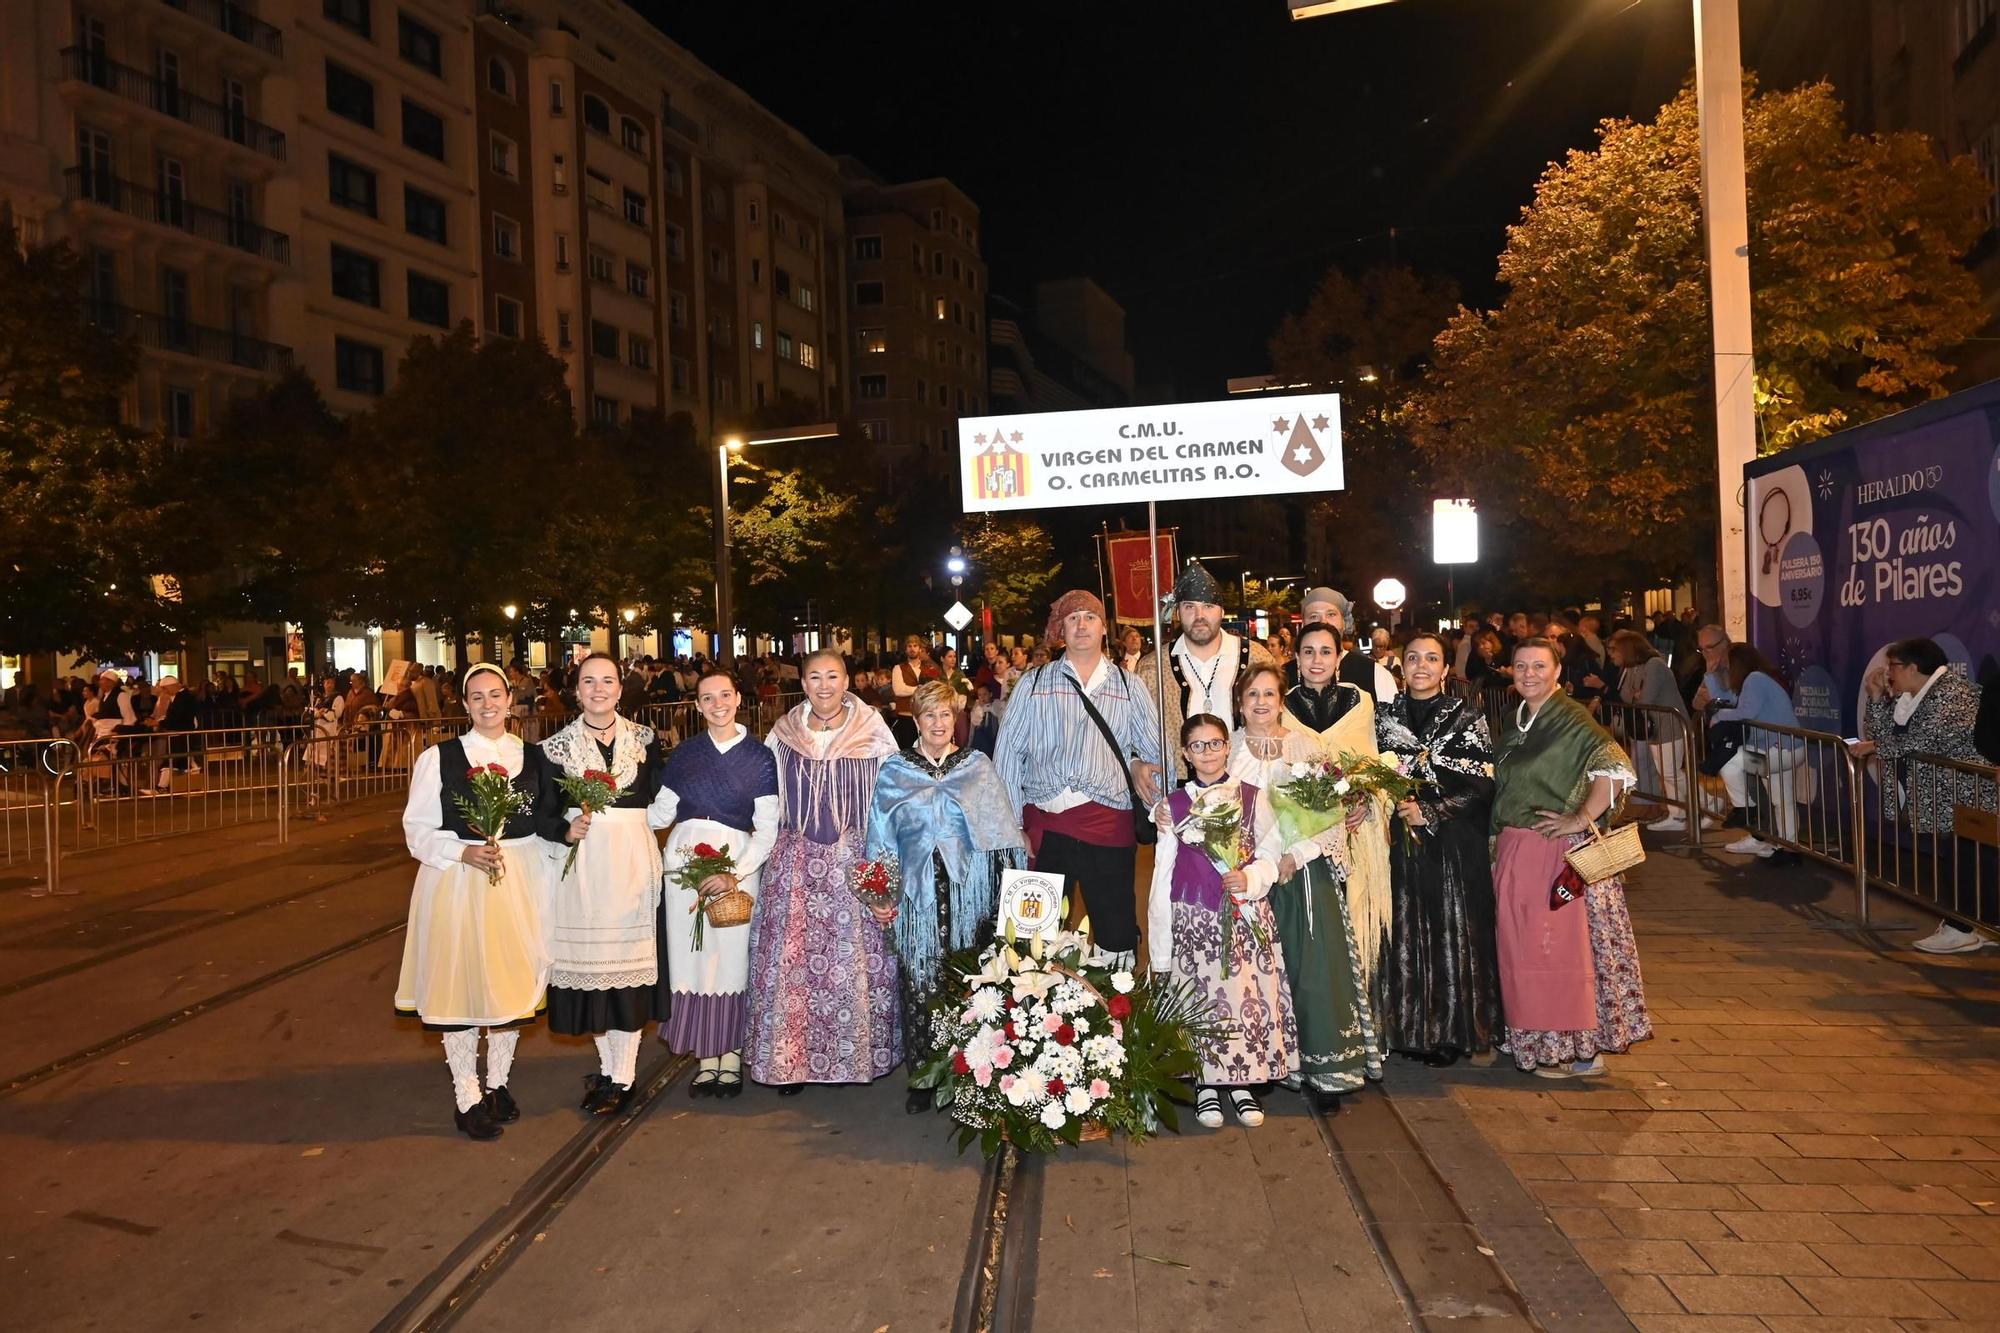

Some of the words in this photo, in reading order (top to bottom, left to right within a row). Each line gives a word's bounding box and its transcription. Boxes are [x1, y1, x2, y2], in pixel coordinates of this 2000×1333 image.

[1118, 421, 1183, 439] C.M.U.
[1041, 449, 1122, 468] VIRGEN
[1130, 445, 1168, 462] DEL
[1175, 439, 1264, 459] CARMEN
[1047, 475, 1072, 491] O.
[1080, 466, 1206, 489] CARMELITAS
[1214, 463, 1260, 480] A.O.
[1858, 471, 1923, 505] HERALDO
[1848, 518, 1891, 563] 130
[1899, 514, 1956, 555] años
[1781, 556, 1809, 570] PULSERA
[1781, 566, 1822, 581] ANIVERSARIO
[1840, 564, 1866, 607] de
[1875, 557, 1963, 602] Pilares
[1800, 685, 1830, 697] MEDALLA
